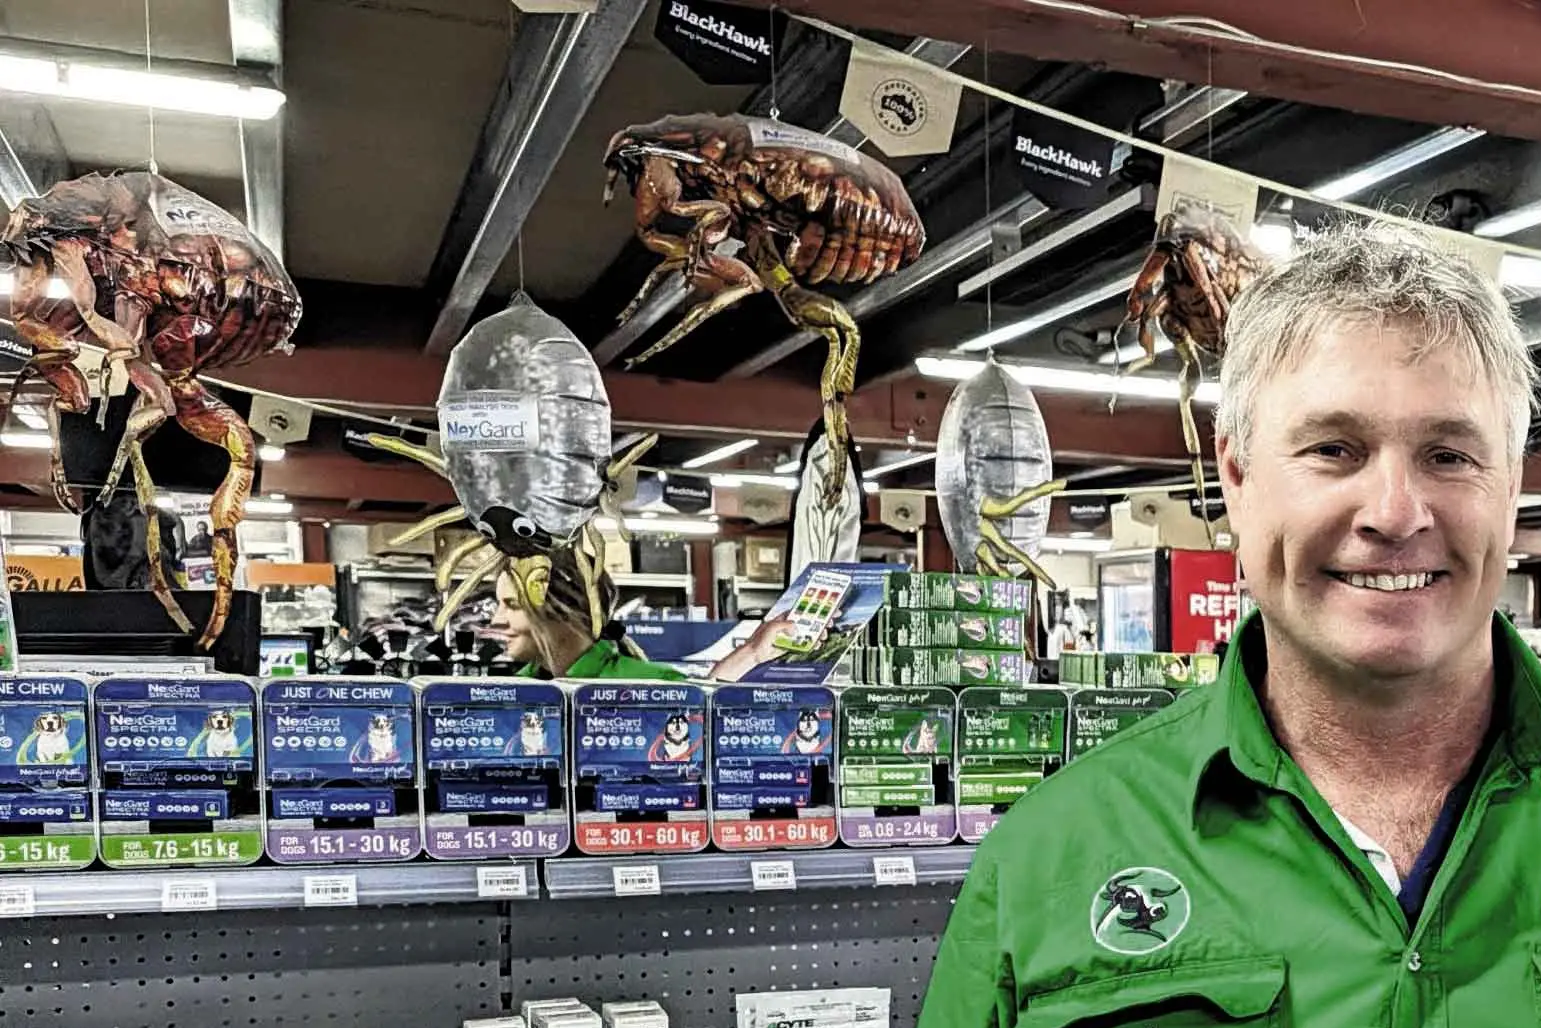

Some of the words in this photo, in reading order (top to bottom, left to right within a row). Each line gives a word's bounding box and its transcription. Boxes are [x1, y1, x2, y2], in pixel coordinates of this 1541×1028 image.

[669, 1, 771, 56] BlackHawk
[884, 98, 915, 120] 100%
[1015, 135, 1103, 178] BlackHawk
[18, 683, 65, 695] CHEW
[148, 683, 200, 693] NexGard
[281, 687, 312, 699] JUST
[316, 686, 348, 699] ONE
[352, 687, 393, 699] CHEW
[470, 687, 517, 697] NexGard
[591, 690, 617, 700] JUST
[620, 689, 648, 700] ONE
[651, 690, 688, 701] CHEW
[753, 690, 793, 699] NexGard
[110, 715, 176, 726] NexGard
[277, 716, 341, 727] NexGard
[435, 717, 495, 727] NexGard
[586, 717, 642, 727] NexGard
[723, 717, 775, 727] NexGard
[744, 825, 775, 842] 30.1
[787, 825, 807, 841] 60
[811, 825, 828, 843] kg
[875, 823, 894, 837] 0.8
[903, 823, 922, 836] 2.4
[923, 822, 938, 838] kg
[437, 832, 456, 840] FOR
[464, 831, 497, 849] 15.1
[512, 830, 534, 848] 30
[538, 830, 558, 851] kg
[610, 828, 643, 845] 30.1
[656, 828, 677, 844] 60
[681, 829, 700, 848] kg
[153, 842, 178, 860] 7.6
[191, 840, 213, 858] 15
[215, 838, 239, 859] kg
[280, 837, 299, 846] FOR
[309, 835, 344, 854] 15.1
[360, 835, 385, 853] 30
[389, 835, 411, 857] kg
[280, 846, 306, 855] DOGS
[437, 841, 461, 849] DOGS
[19, 843, 45, 861] 15
[48, 842, 71, 863] kg
